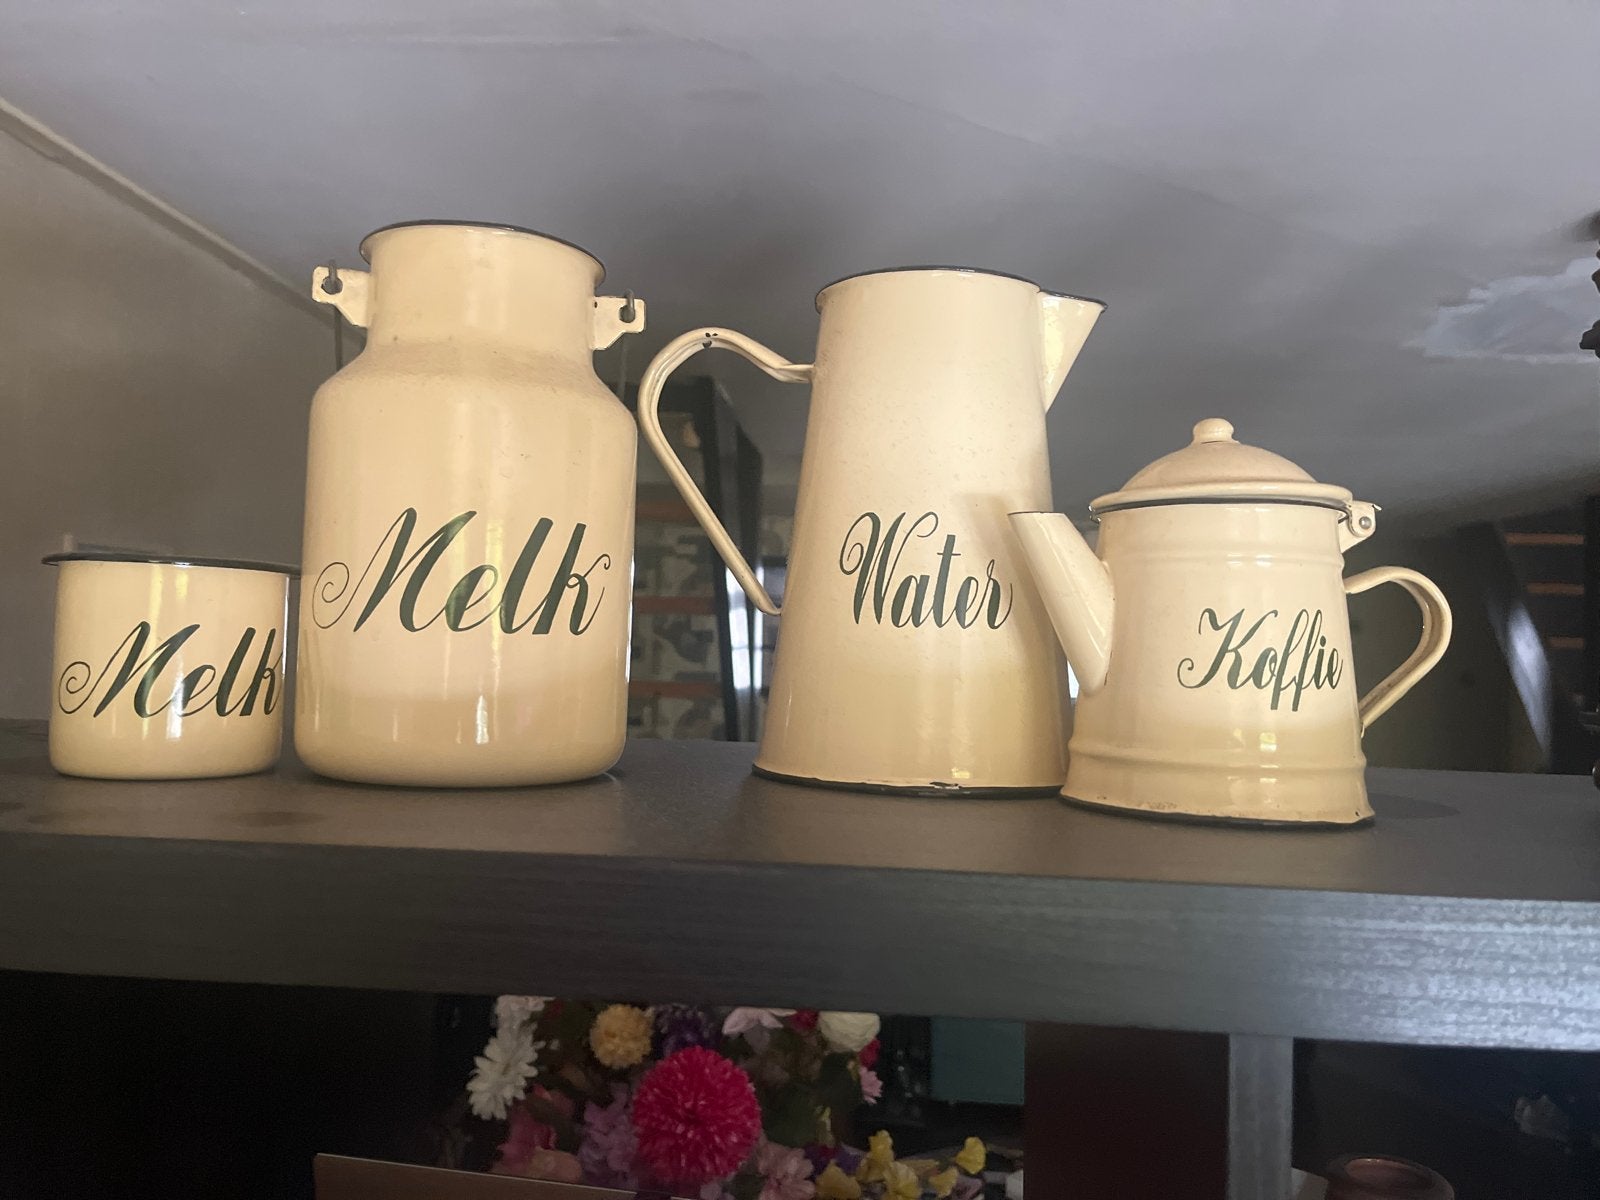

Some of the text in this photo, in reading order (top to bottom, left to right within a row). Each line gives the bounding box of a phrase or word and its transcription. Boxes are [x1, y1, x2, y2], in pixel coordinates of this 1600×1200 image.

[312, 507, 610, 636] Melk
[839, 511, 1013, 630] Water
[58, 621, 283, 718] Melk
[1177, 608, 1343, 712] Koffie
